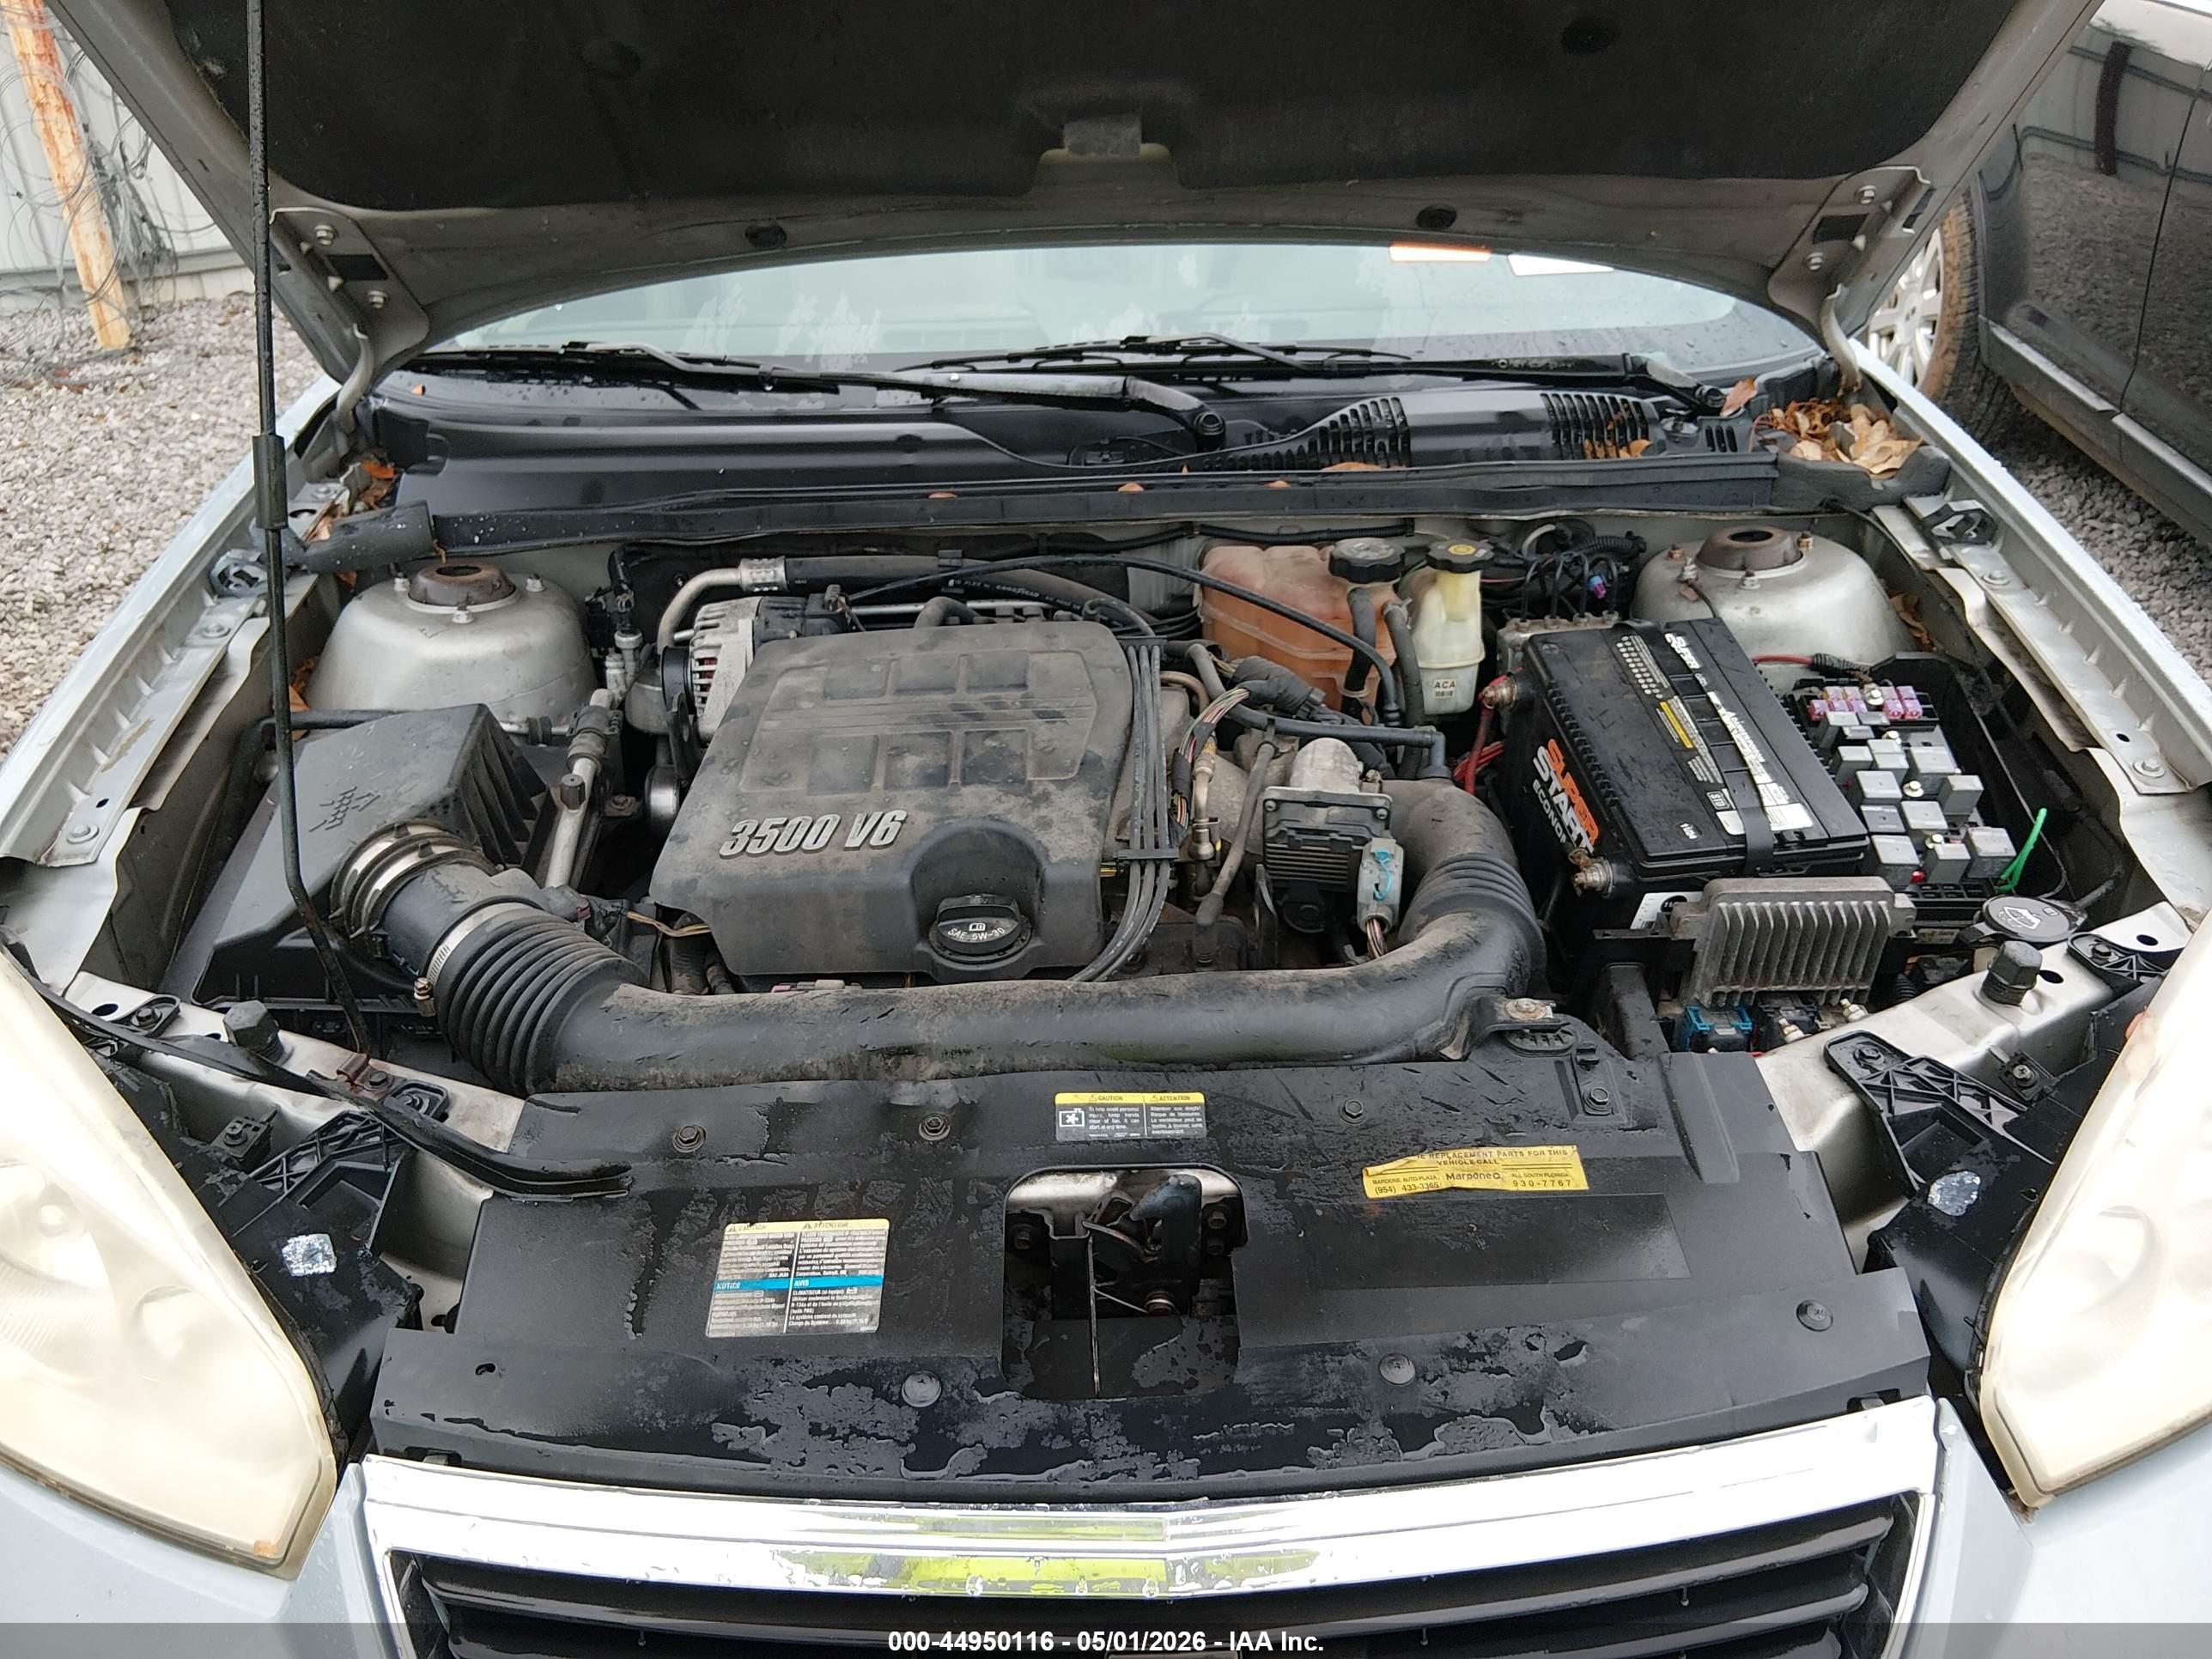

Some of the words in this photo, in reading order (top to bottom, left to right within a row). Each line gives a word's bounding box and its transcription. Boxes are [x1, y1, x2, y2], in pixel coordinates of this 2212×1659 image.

[1434, 680, 1456, 689] ACA
[1547, 738, 1600, 846] SUPER
[1533, 745, 1595, 855] START
[720, 813, 842, 859] 3500
[843, 810, 908, 852] V6
[947, 927, 968, 939] SAE
[971, 927, 1006, 940] 5W-30
[1429, 1151, 1492, 1159] REPLACEMENT
[1512, 1179, 1572, 1188] 930-7767
[1375, 1185, 1396, 1195] (954)
